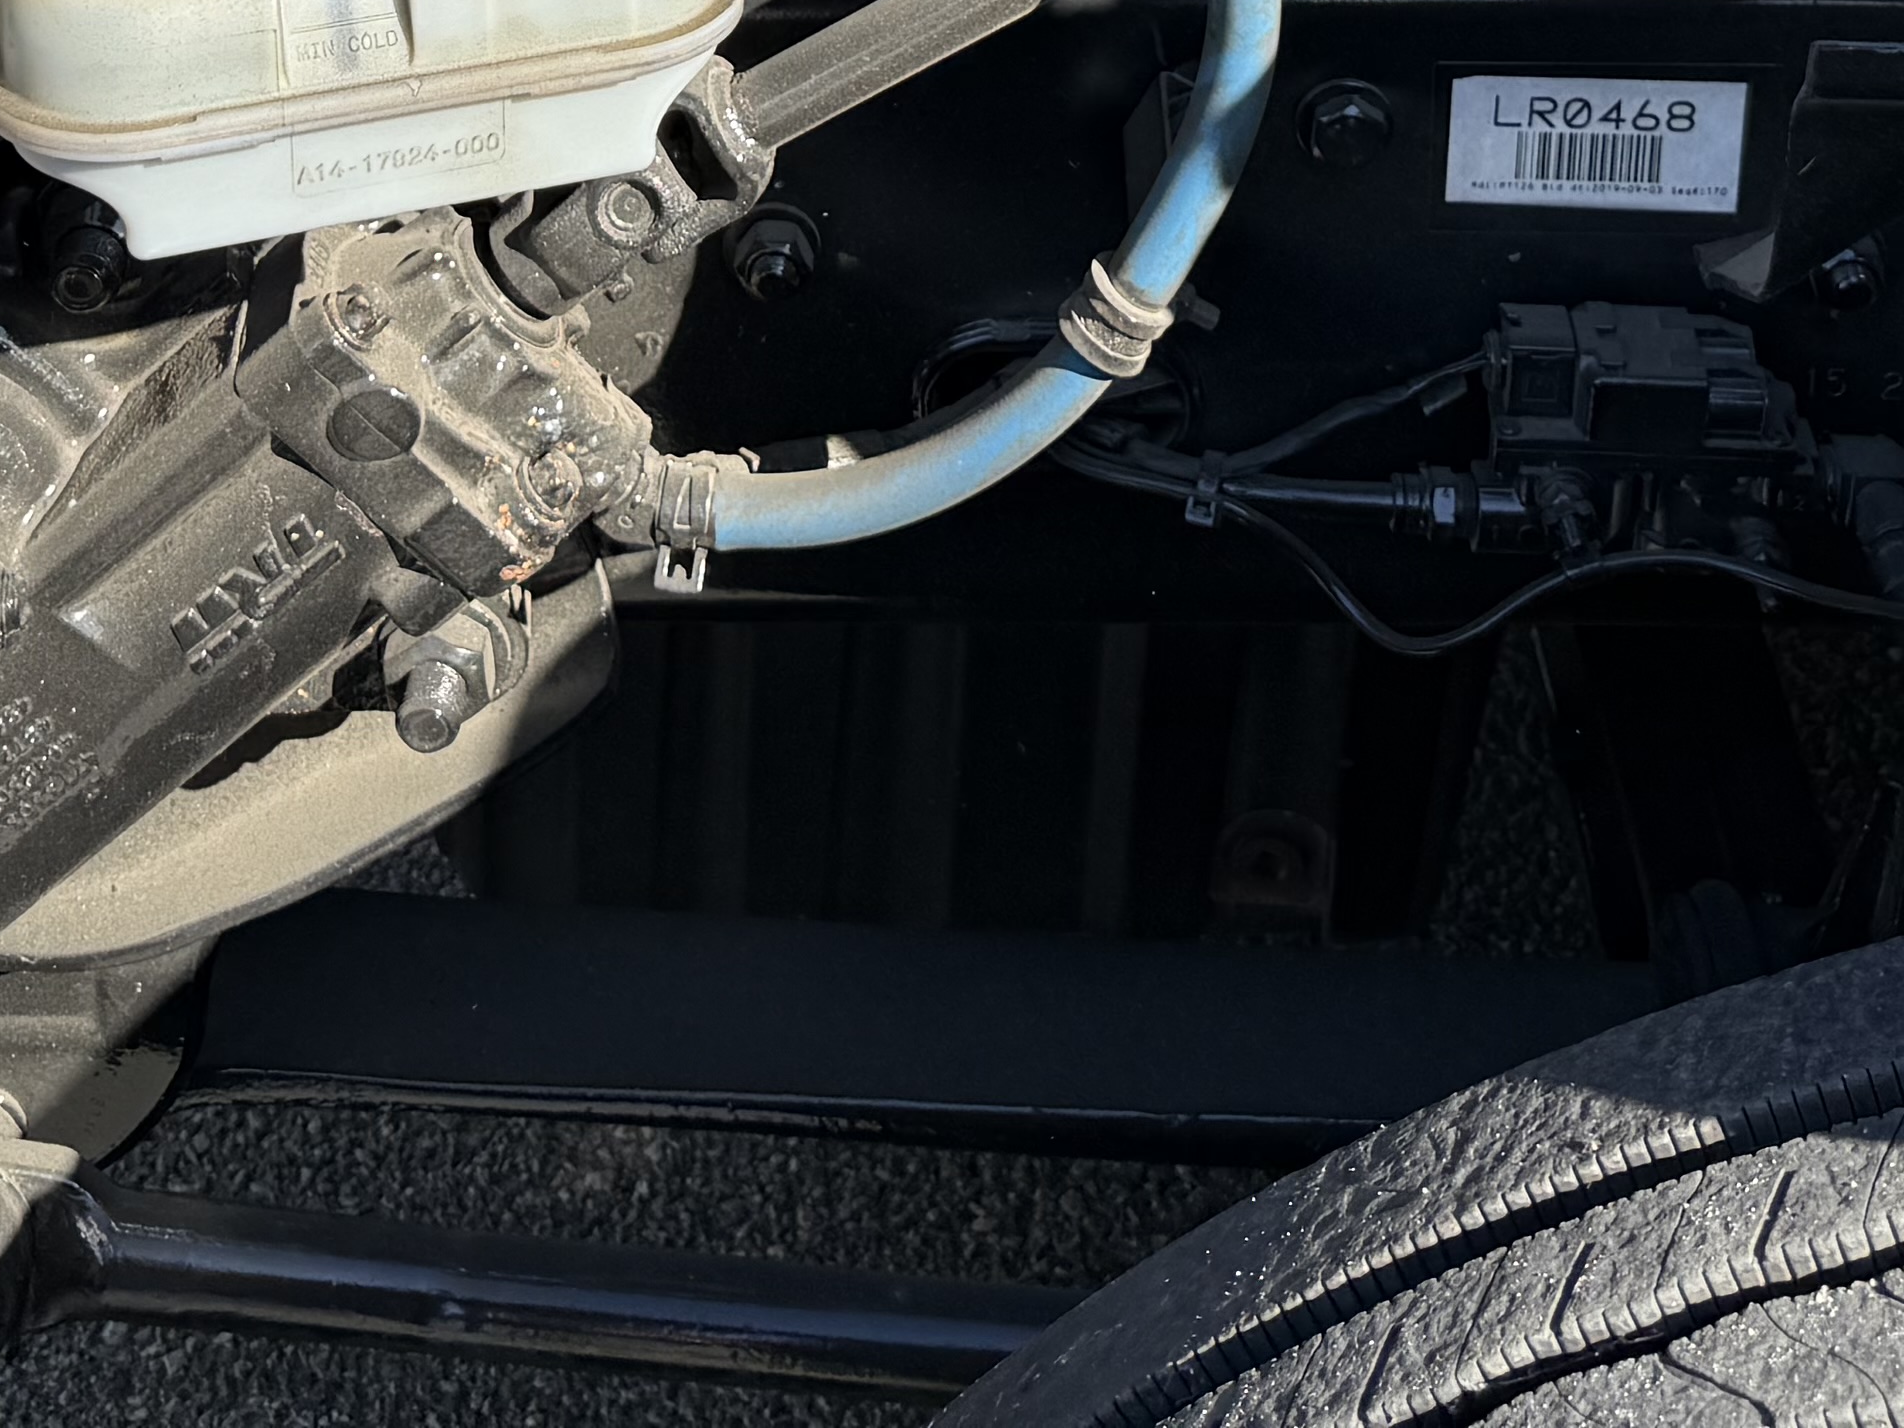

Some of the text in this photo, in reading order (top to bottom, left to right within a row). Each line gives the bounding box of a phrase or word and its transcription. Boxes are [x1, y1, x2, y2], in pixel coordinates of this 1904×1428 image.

[297, 29, 399, 62] MIN COLD
[1494, 93, 1697, 133] LR0468
[1542, 182, 1563, 192] Bld
[1807, 368, 1847, 398] 15
